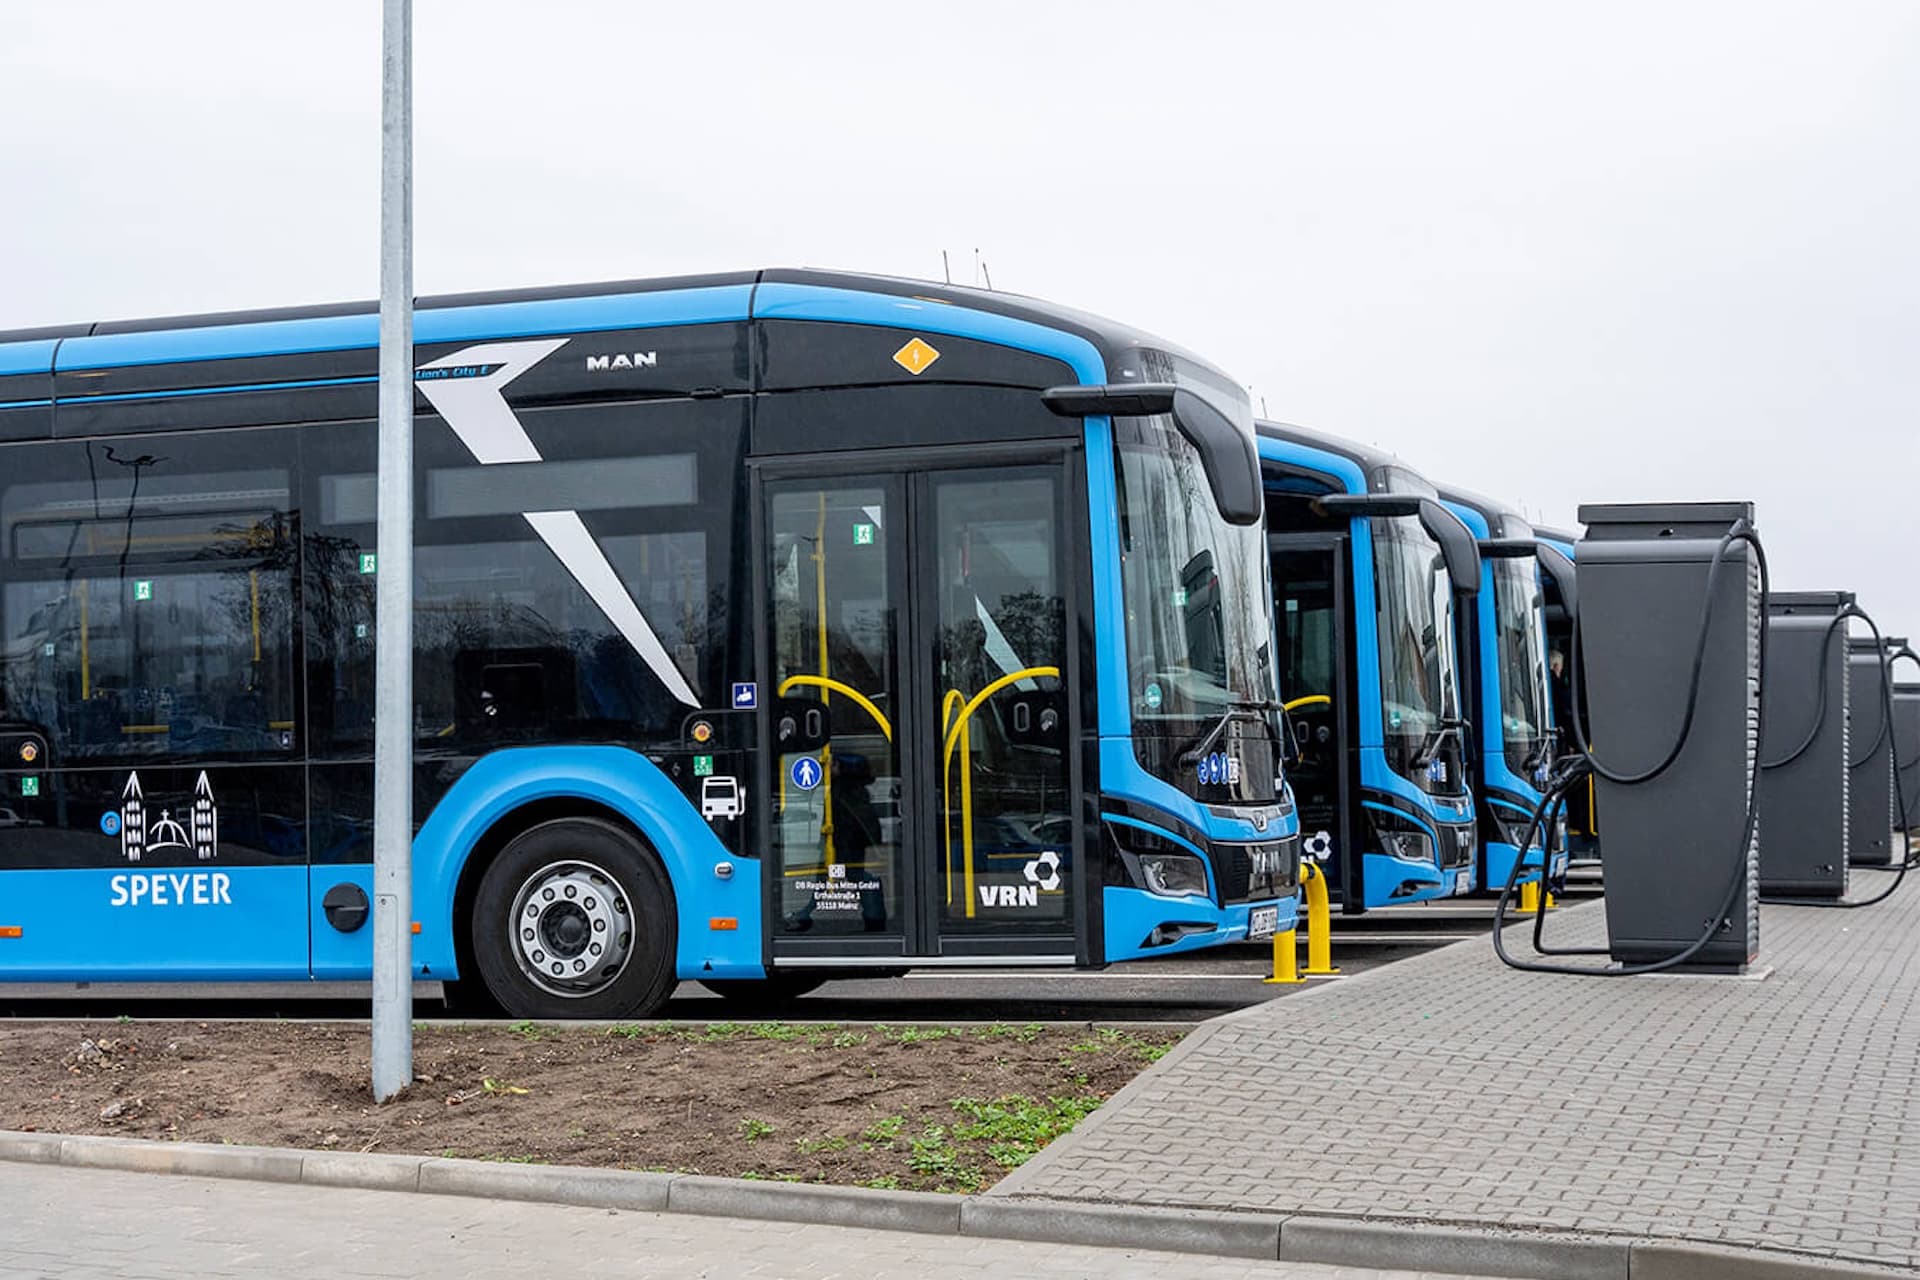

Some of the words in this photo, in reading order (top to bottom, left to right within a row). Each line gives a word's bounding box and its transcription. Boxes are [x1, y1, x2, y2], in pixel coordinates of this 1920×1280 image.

[587, 351, 657, 371] MAN
[415, 369, 449, 379] Lion's
[453, 366, 477, 377] City
[481, 364, 489, 375] E
[110, 872, 232, 907] SPEYER
[795, 881, 806, 890] DB
[806, 881, 826, 891] Regio
[839, 881, 858, 890] Mitte
[858, 881, 880, 890] GmbH
[979, 885, 1037, 907] VRN
[837, 901, 859, 911] Mainz
